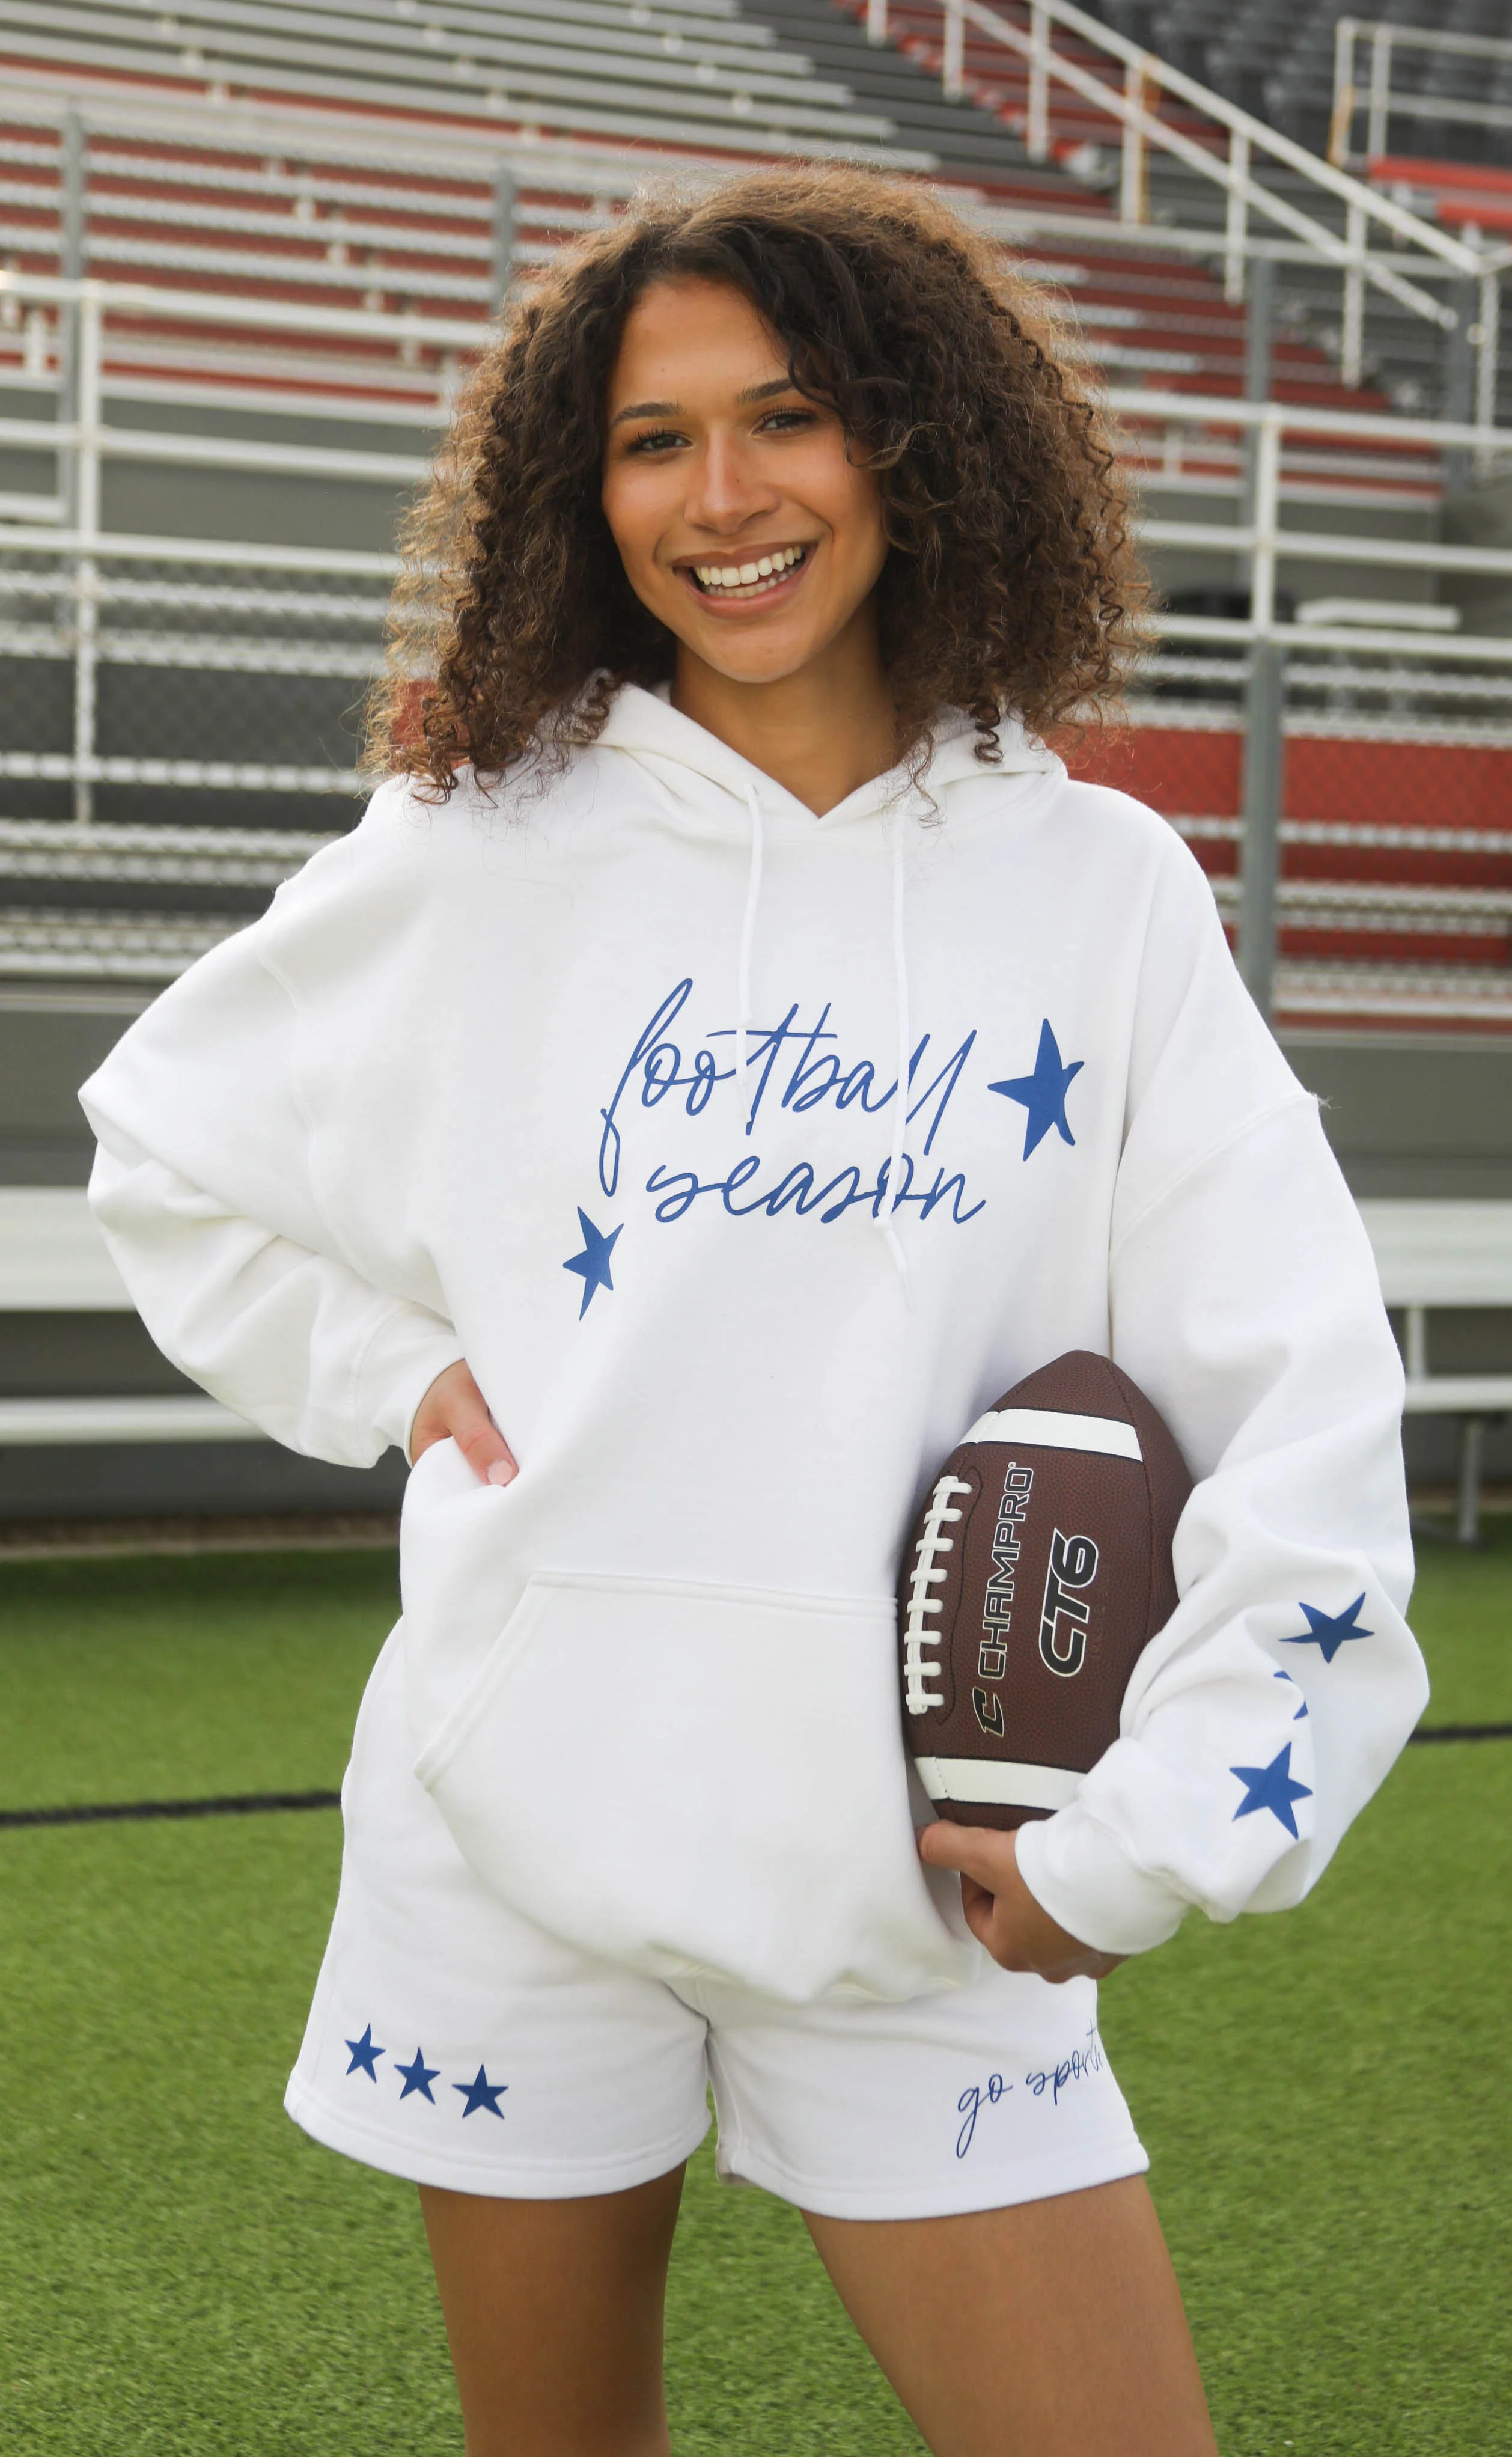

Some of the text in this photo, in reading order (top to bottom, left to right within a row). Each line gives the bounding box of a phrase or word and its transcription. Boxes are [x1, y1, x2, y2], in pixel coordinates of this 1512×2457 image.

[599, 978, 977, 1197] football
[645, 1153, 986, 1224] season
[978, 1467, 1034, 1680] CHAMPRO
[1038, 1527, 1099, 1677] CT6
[956, 2073, 1014, 2159] go
